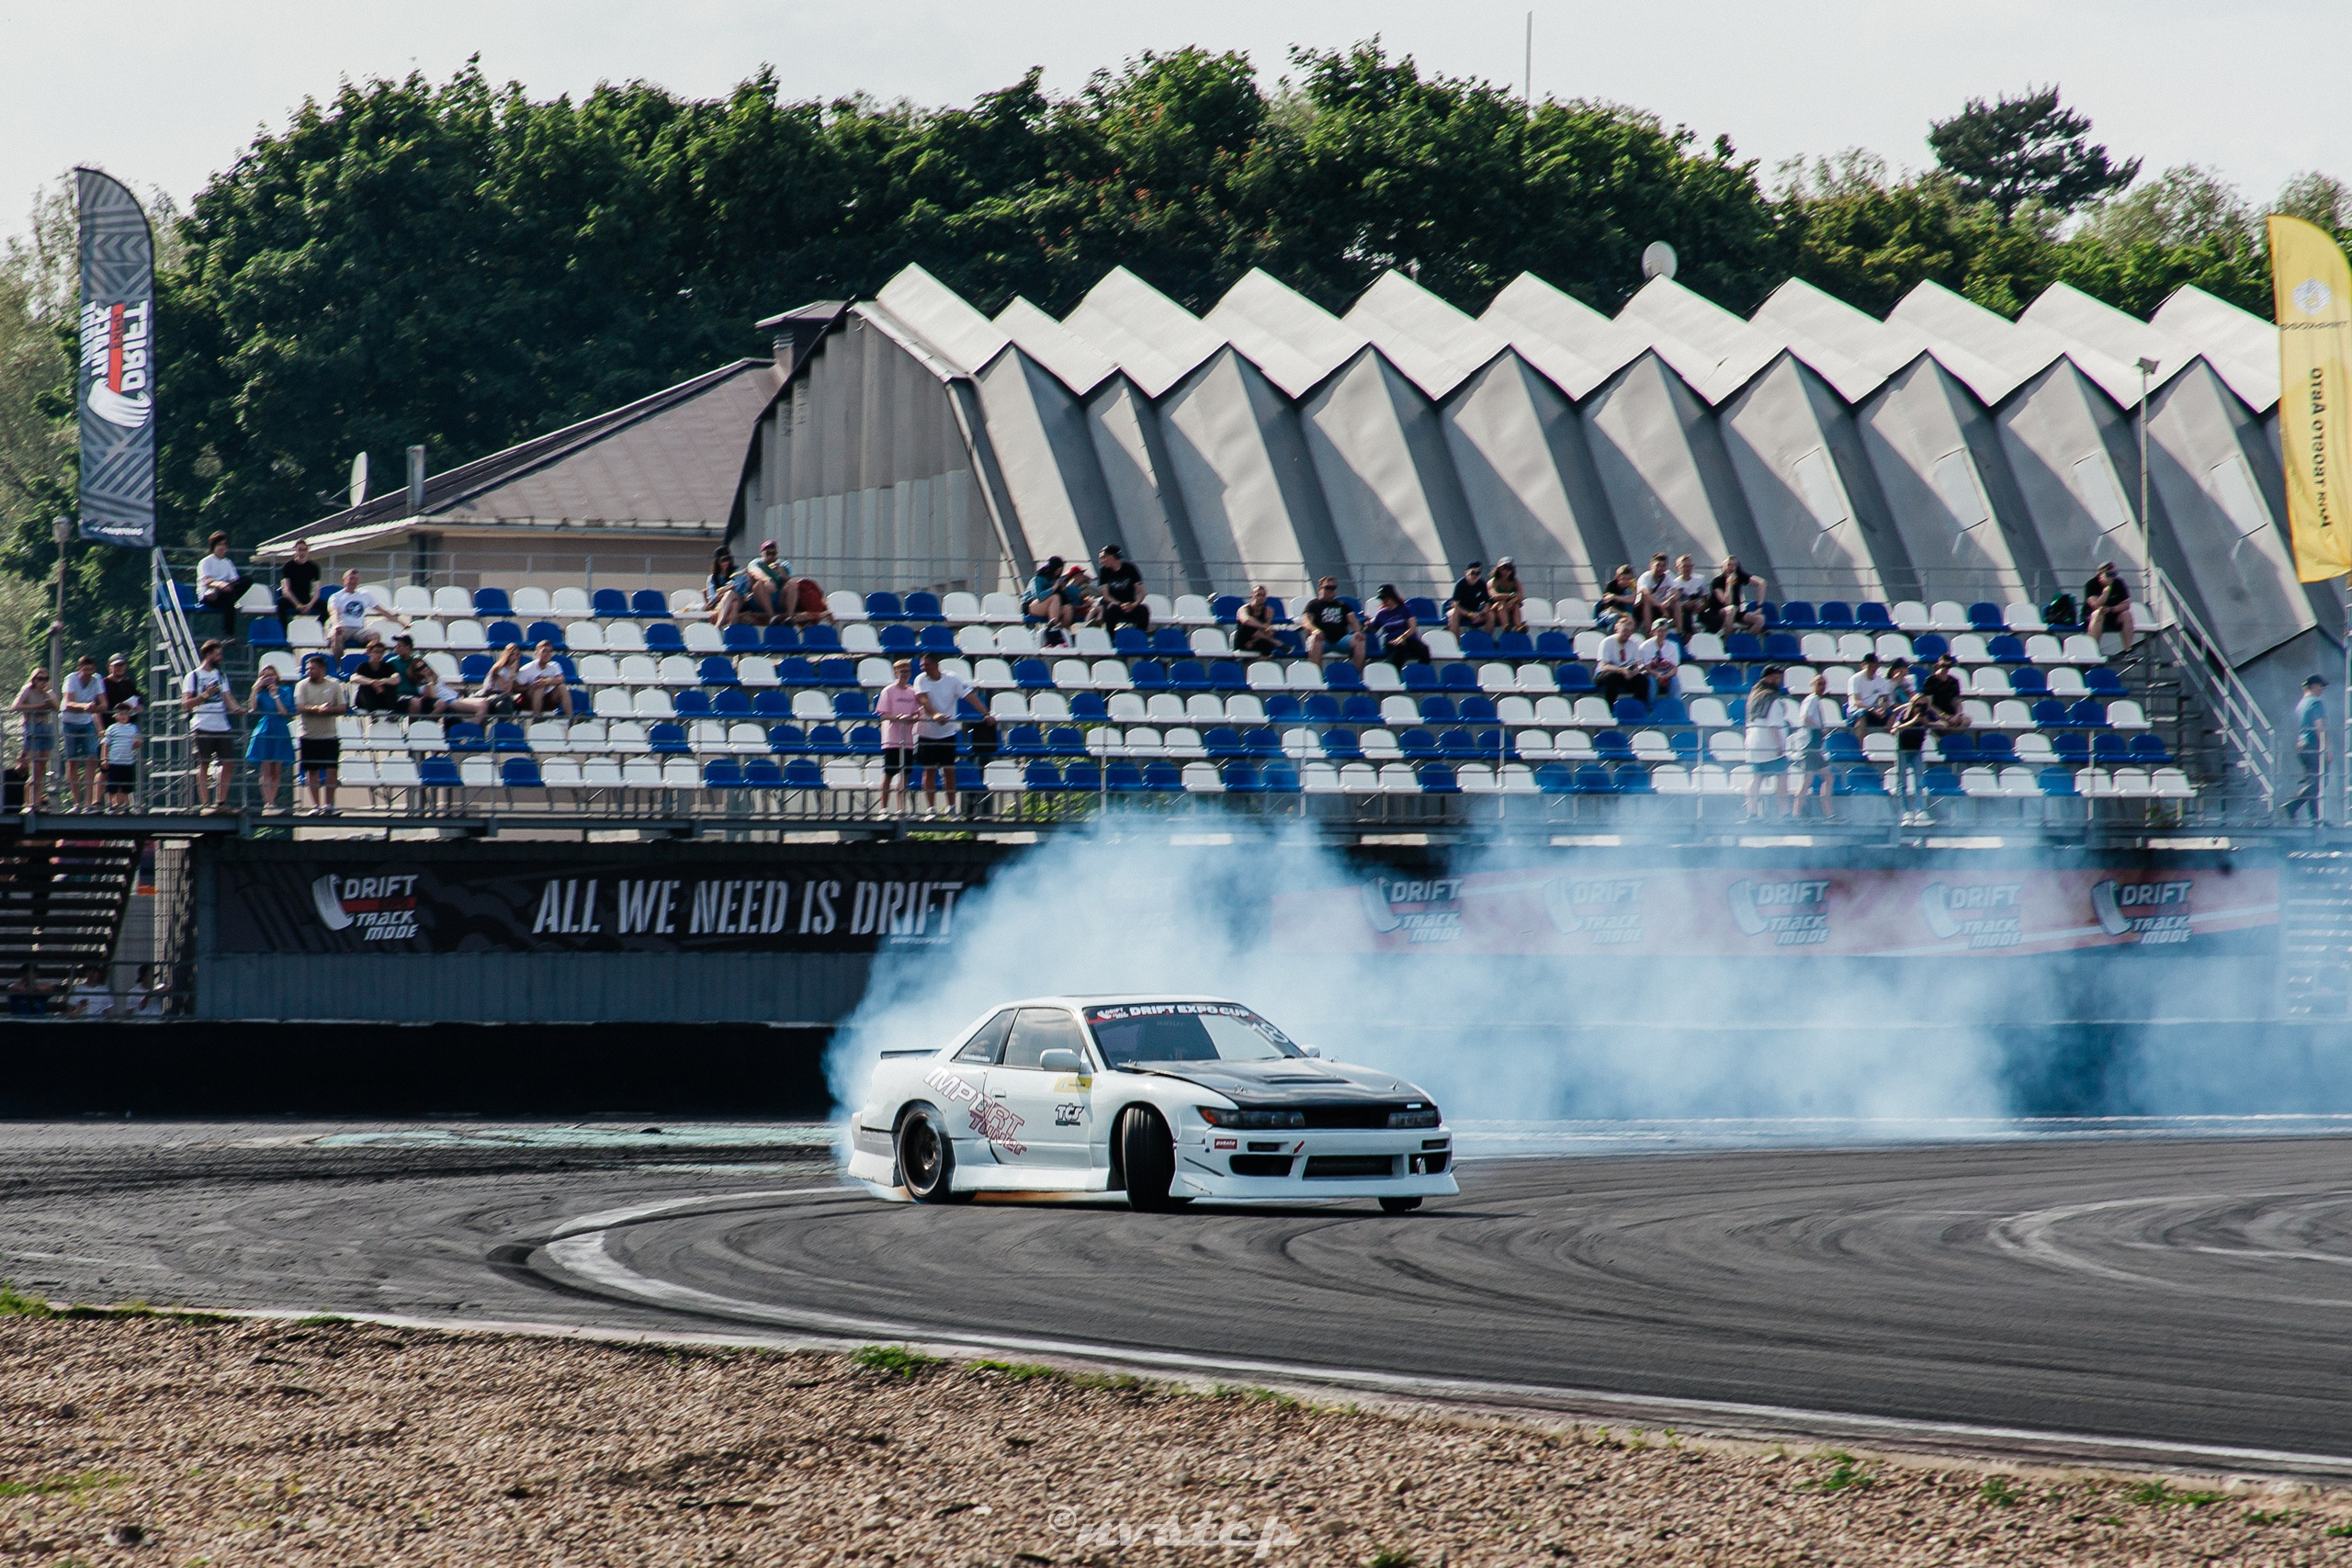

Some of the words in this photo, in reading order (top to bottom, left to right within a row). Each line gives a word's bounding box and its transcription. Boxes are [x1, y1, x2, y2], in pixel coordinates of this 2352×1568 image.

[344, 874, 419, 899] DRIFT
[1390, 878, 1464, 902] DRIFT
[1758, 880, 1830, 905] DRIFT
[2120, 881, 2193, 906] DRIFT
[1950, 884, 2021, 908] DRIFT
[532, 879, 602, 934] ALL
[617, 879, 681, 934] WE
[688, 879, 789, 934] NEED
[798, 880, 842, 935] IS
[849, 880, 964, 935] DRIFT
[356, 910, 415, 927] TRACK
[1403, 912, 1461, 930] TRACK
[1770, 914, 1827, 931] TRACK
[2132, 915, 2189, 931] TRACK
[364, 924, 419, 941] MODE
[1776, 928, 1830, 945] MODE
[2141, 928, 2192, 944] MODE
[1129, 1004, 1176, 1017] DRIFT
[1176, 1004, 1218, 1015] EXPO
[1219, 1006, 1250, 1018] CUP
[923, 1065, 1025, 1136] IMPORT
